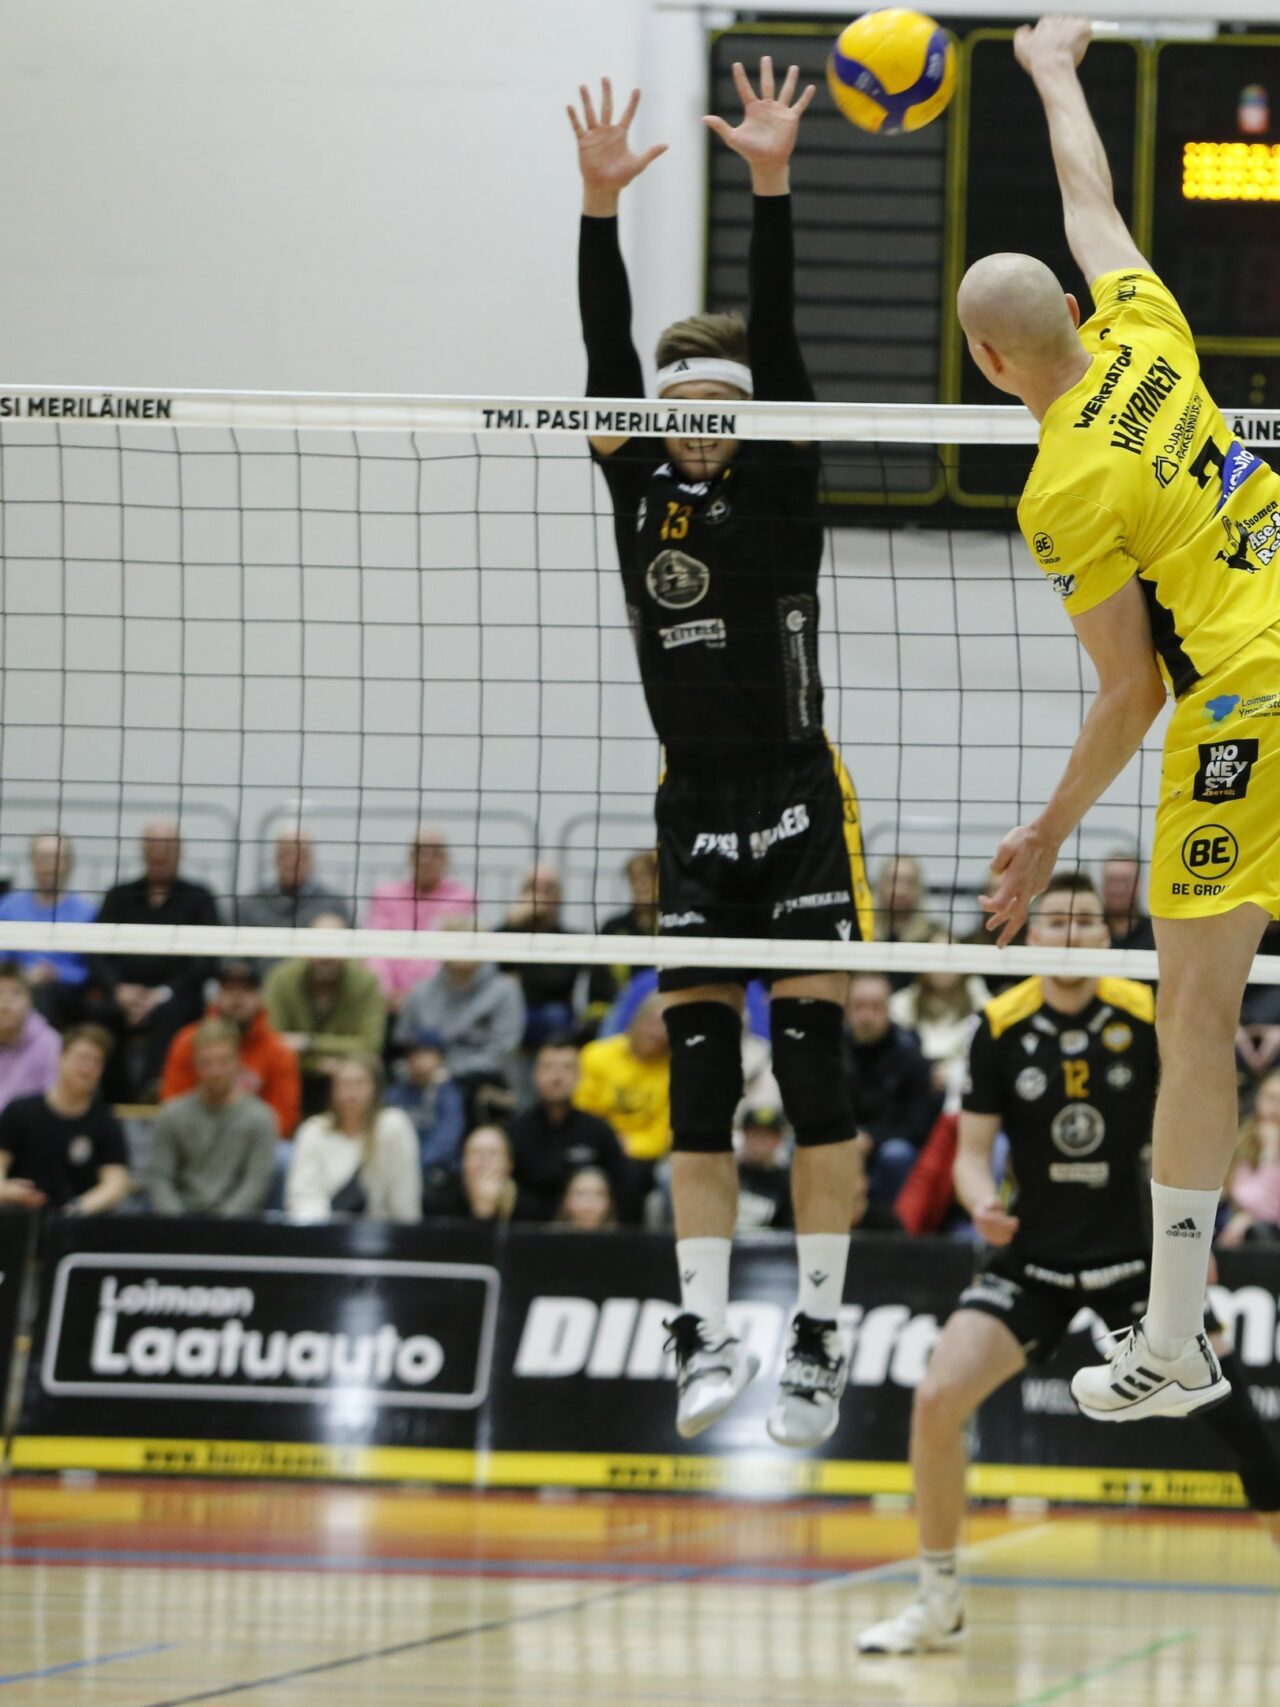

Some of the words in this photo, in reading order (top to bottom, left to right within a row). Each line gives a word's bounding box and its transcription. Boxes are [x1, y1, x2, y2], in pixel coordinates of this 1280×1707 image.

[28, 393, 172, 418] MERILÄINEN
[1110, 355, 1182, 455] HÄYRINEN
[482, 409, 530, 429] TMI.
[536, 410, 588, 430] PASI
[595, 408, 736, 434] MERILÄINEN
[1243, 500, 1279, 529] Suomen
[1036, 537, 1051, 553] BE
[1248, 525, 1276, 551] Ase
[1189, 836, 1231, 867] BE
[1172, 883, 1190, 895] BE
[1062, 1059, 1091, 1097] 12
[101, 1275, 254, 1317] Loimaan
[91, 1308, 445, 1385] Laatuauto
